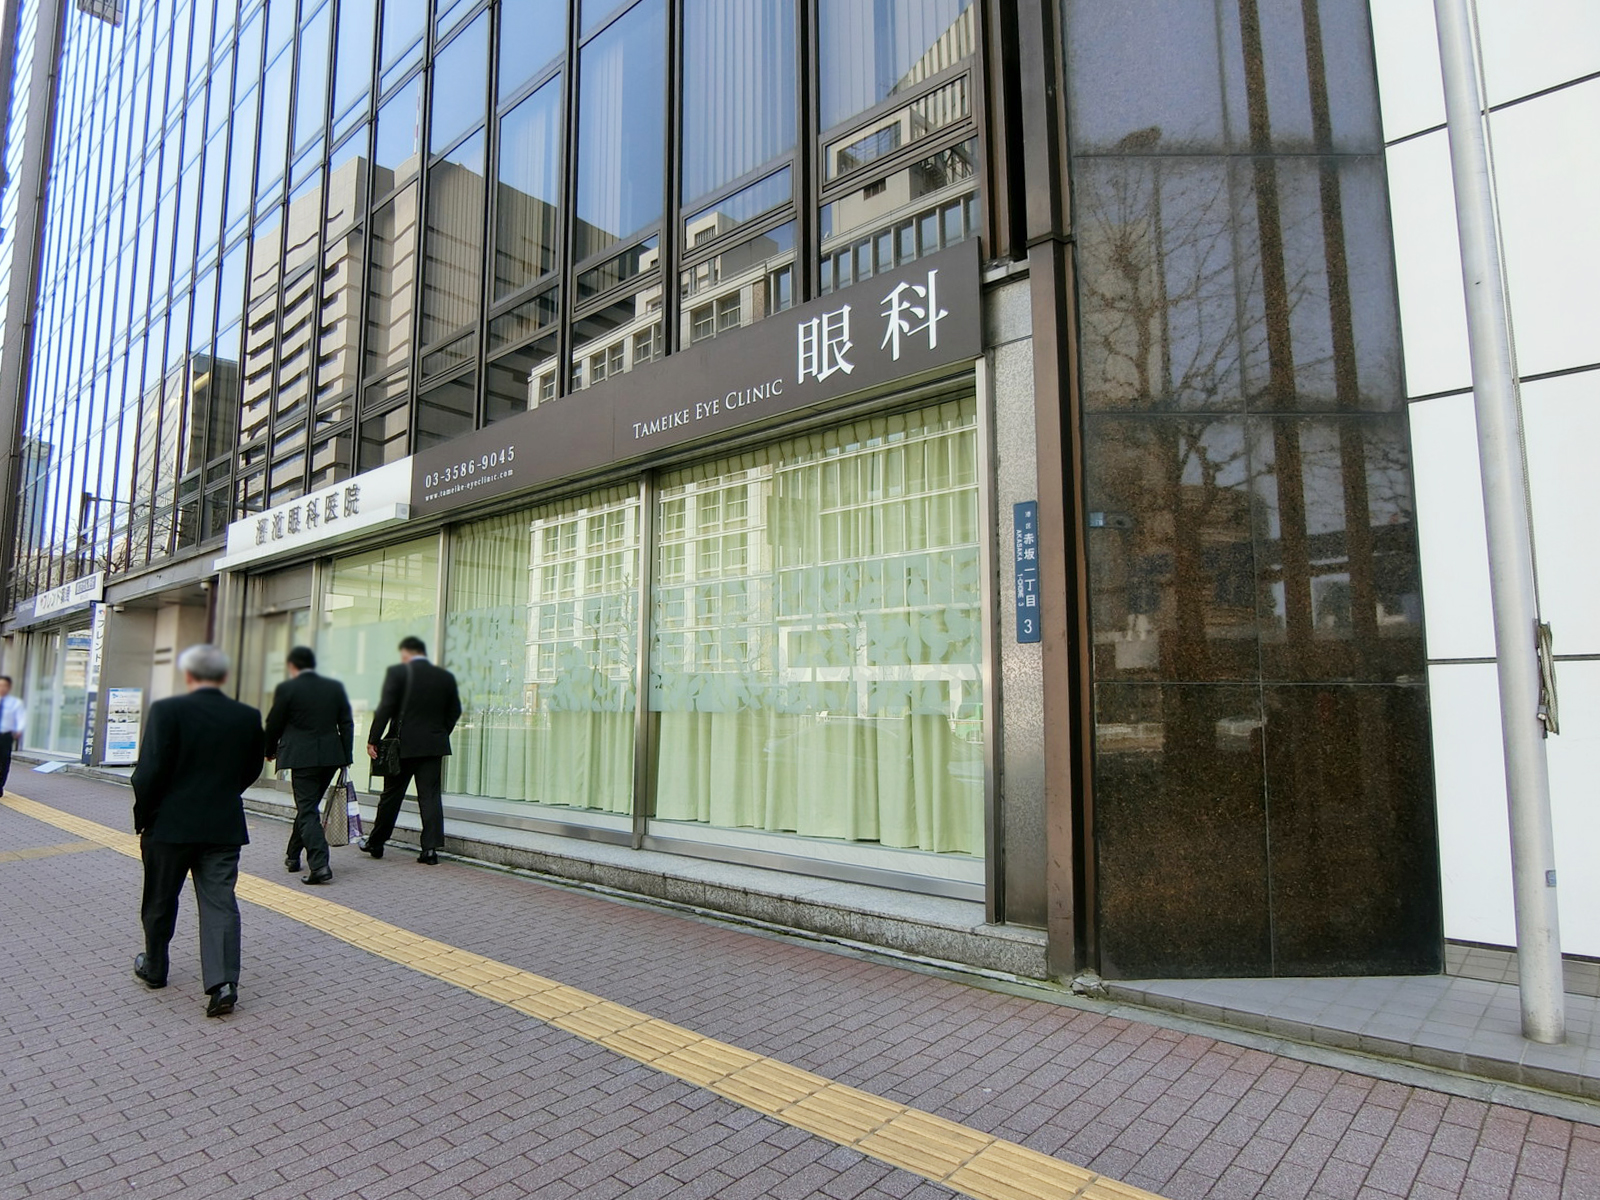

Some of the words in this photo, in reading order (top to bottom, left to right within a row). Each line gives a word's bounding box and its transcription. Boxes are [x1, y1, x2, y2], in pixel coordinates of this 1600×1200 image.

[798, 269, 949, 385] 眼科
[633, 409, 690, 440] TAMEIKE
[695, 400, 721, 421] EYE
[725, 379, 784, 411] CLINIC
[425, 446, 515, 488] 03-3586-9045
[425, 469, 513, 502] www.tameike-eyeclinic.com
[1024, 533, 1036, 607] 赤坂一丁目
[1023, 619, 1033, 634] 3
